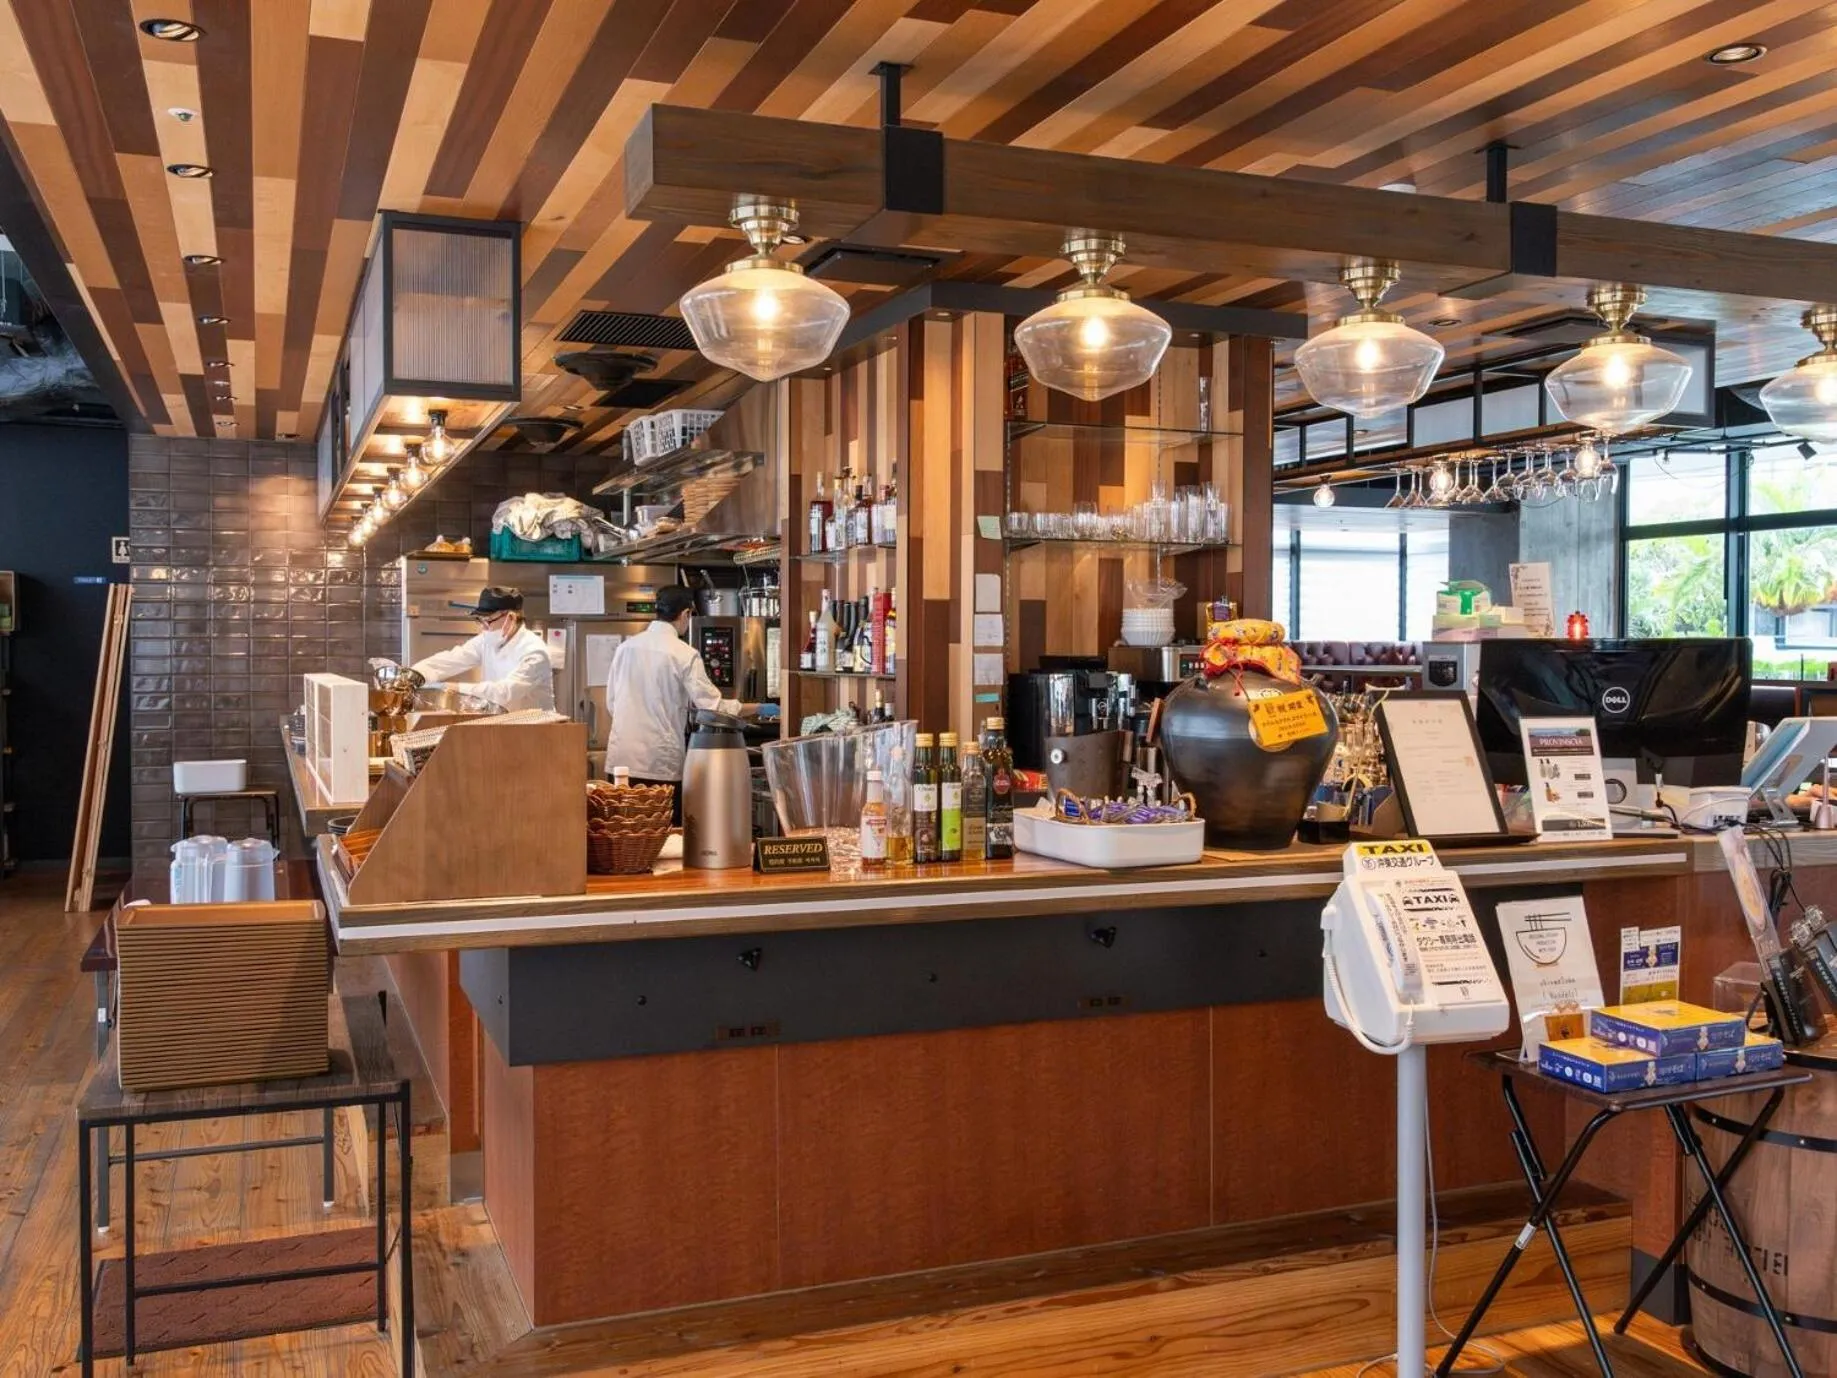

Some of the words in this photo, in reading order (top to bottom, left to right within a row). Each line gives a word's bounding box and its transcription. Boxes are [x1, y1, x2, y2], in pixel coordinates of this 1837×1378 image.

[1605, 696, 1627, 704] DELL
[764, 843, 823, 856] RESERVED
[1363, 843, 1425, 855] TAXI
[1412, 895, 1448, 904] TAXI
